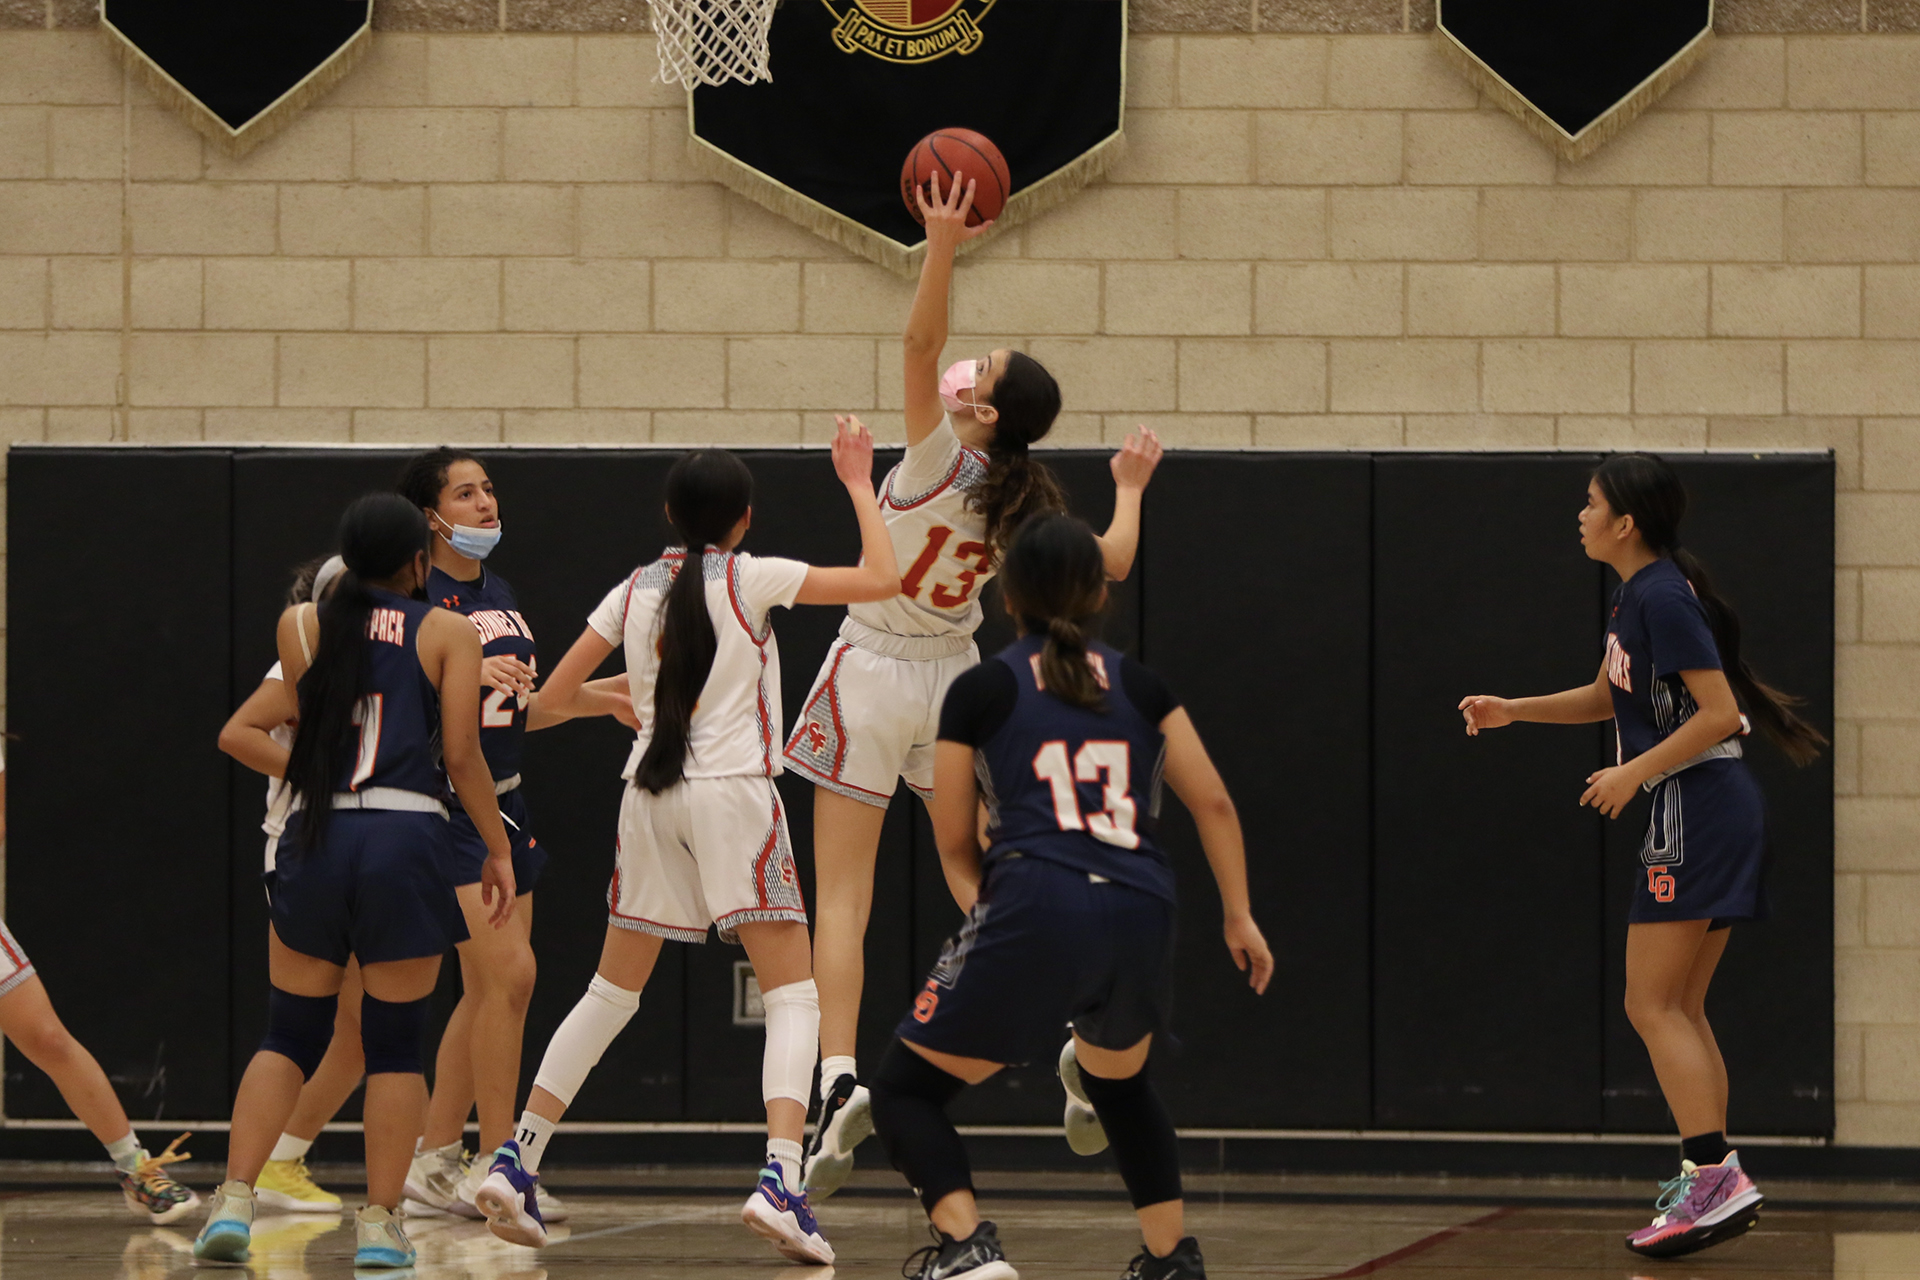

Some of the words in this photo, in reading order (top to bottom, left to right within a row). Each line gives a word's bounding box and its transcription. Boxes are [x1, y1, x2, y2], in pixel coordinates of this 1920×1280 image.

[855, 26, 886, 51] PAX
[885, 38, 905, 56] ET
[906, 26, 960, 57] BONUM
[900, 525, 992, 610] 13
[364, 608, 406, 647] PACK
[1032, 739, 1140, 850] 13
[519, 1128, 537, 1147] 11
